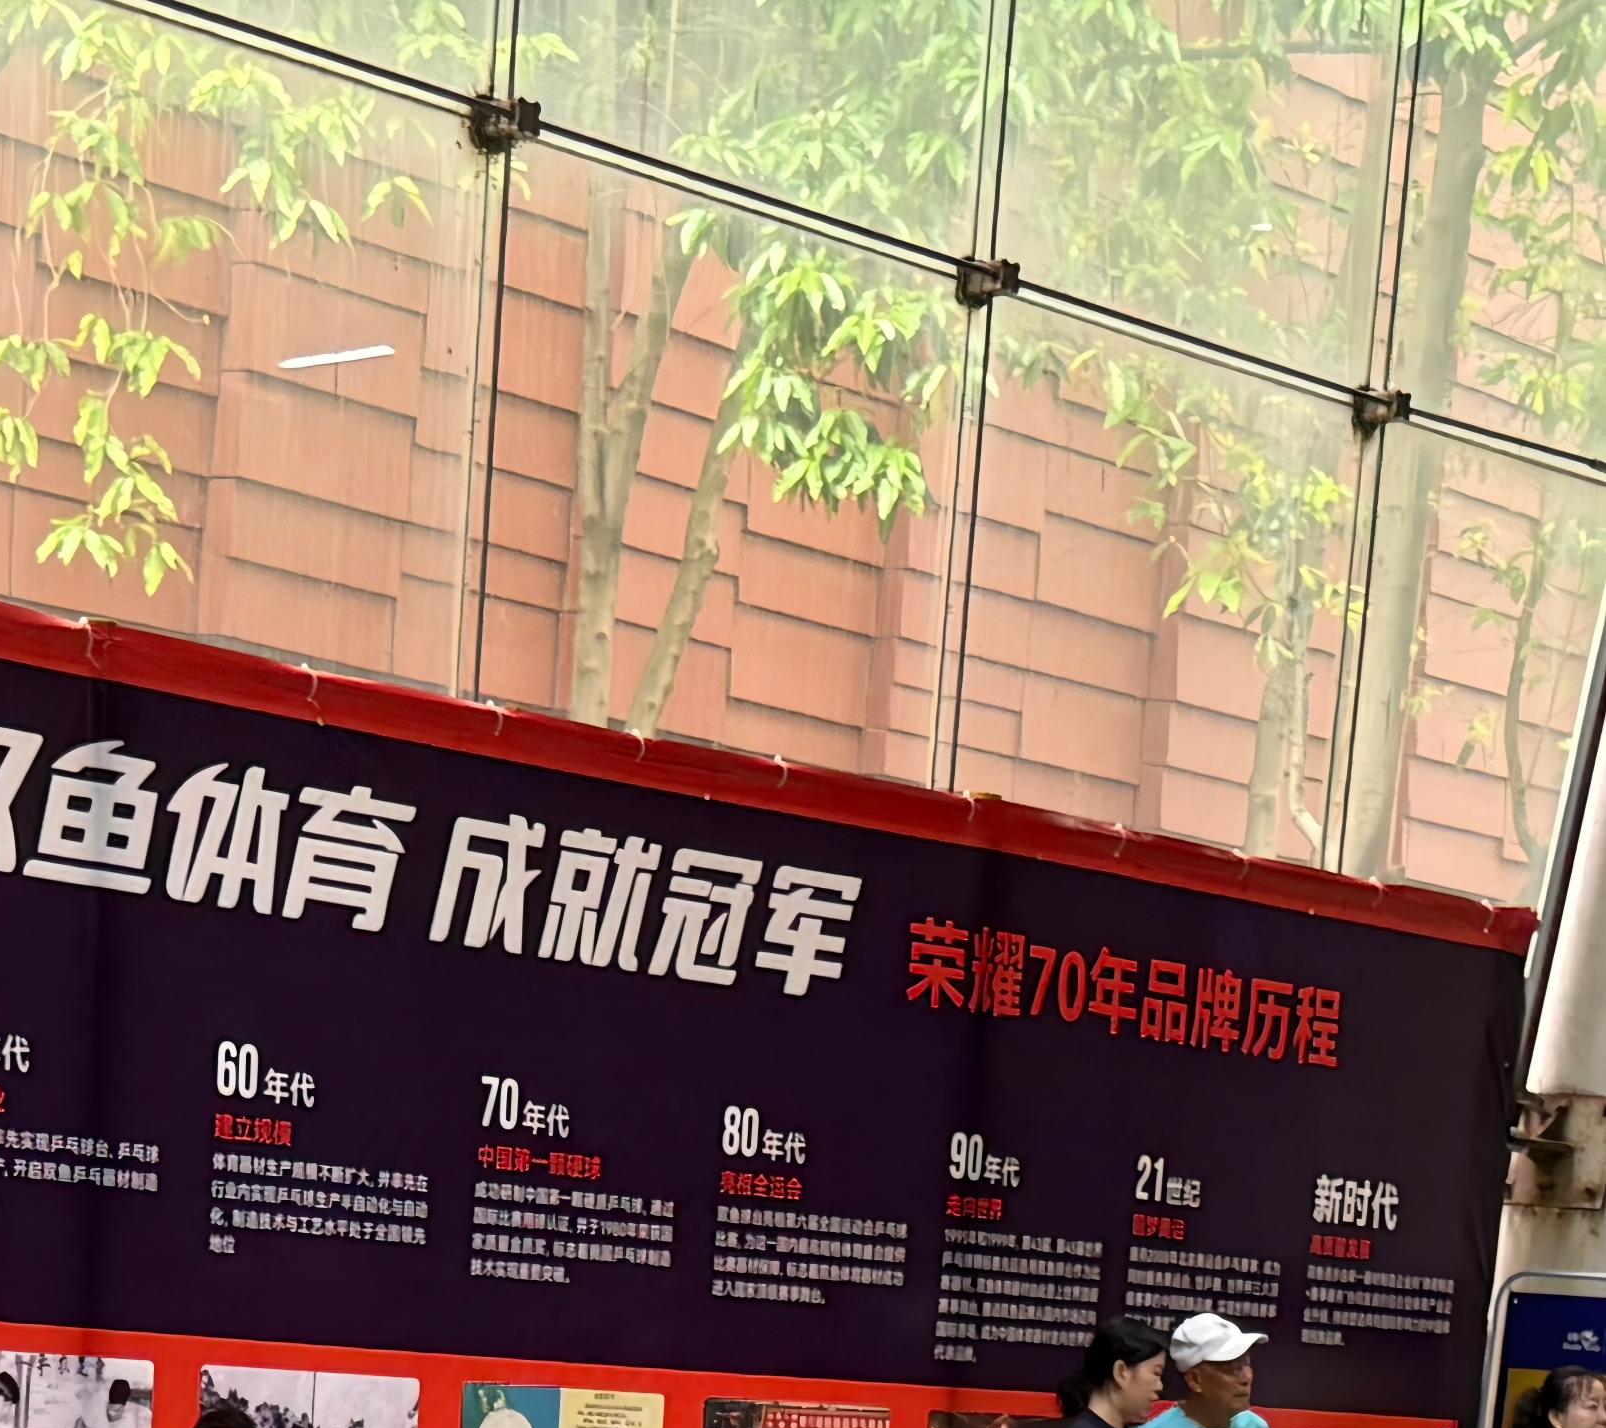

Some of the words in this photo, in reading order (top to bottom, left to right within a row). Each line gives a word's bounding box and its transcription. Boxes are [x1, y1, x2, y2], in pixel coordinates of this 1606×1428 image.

[429, 814, 862, 996] 成就冠军
[905, 916, 1341, 1068] 荣耀70年品牌历程
[216, 1040, 316, 1108] 60年代
[214, 1113, 292, 1147] 建立规模
[481, 1075, 570, 1138] 70年代
[722, 1105, 806, 1165] 80年代
[949, 1131, 1020, 1187] 90年代
[1135, 1154, 1201, 1208] 21世纪
[1312, 1173, 1399, 1231] 新时代
